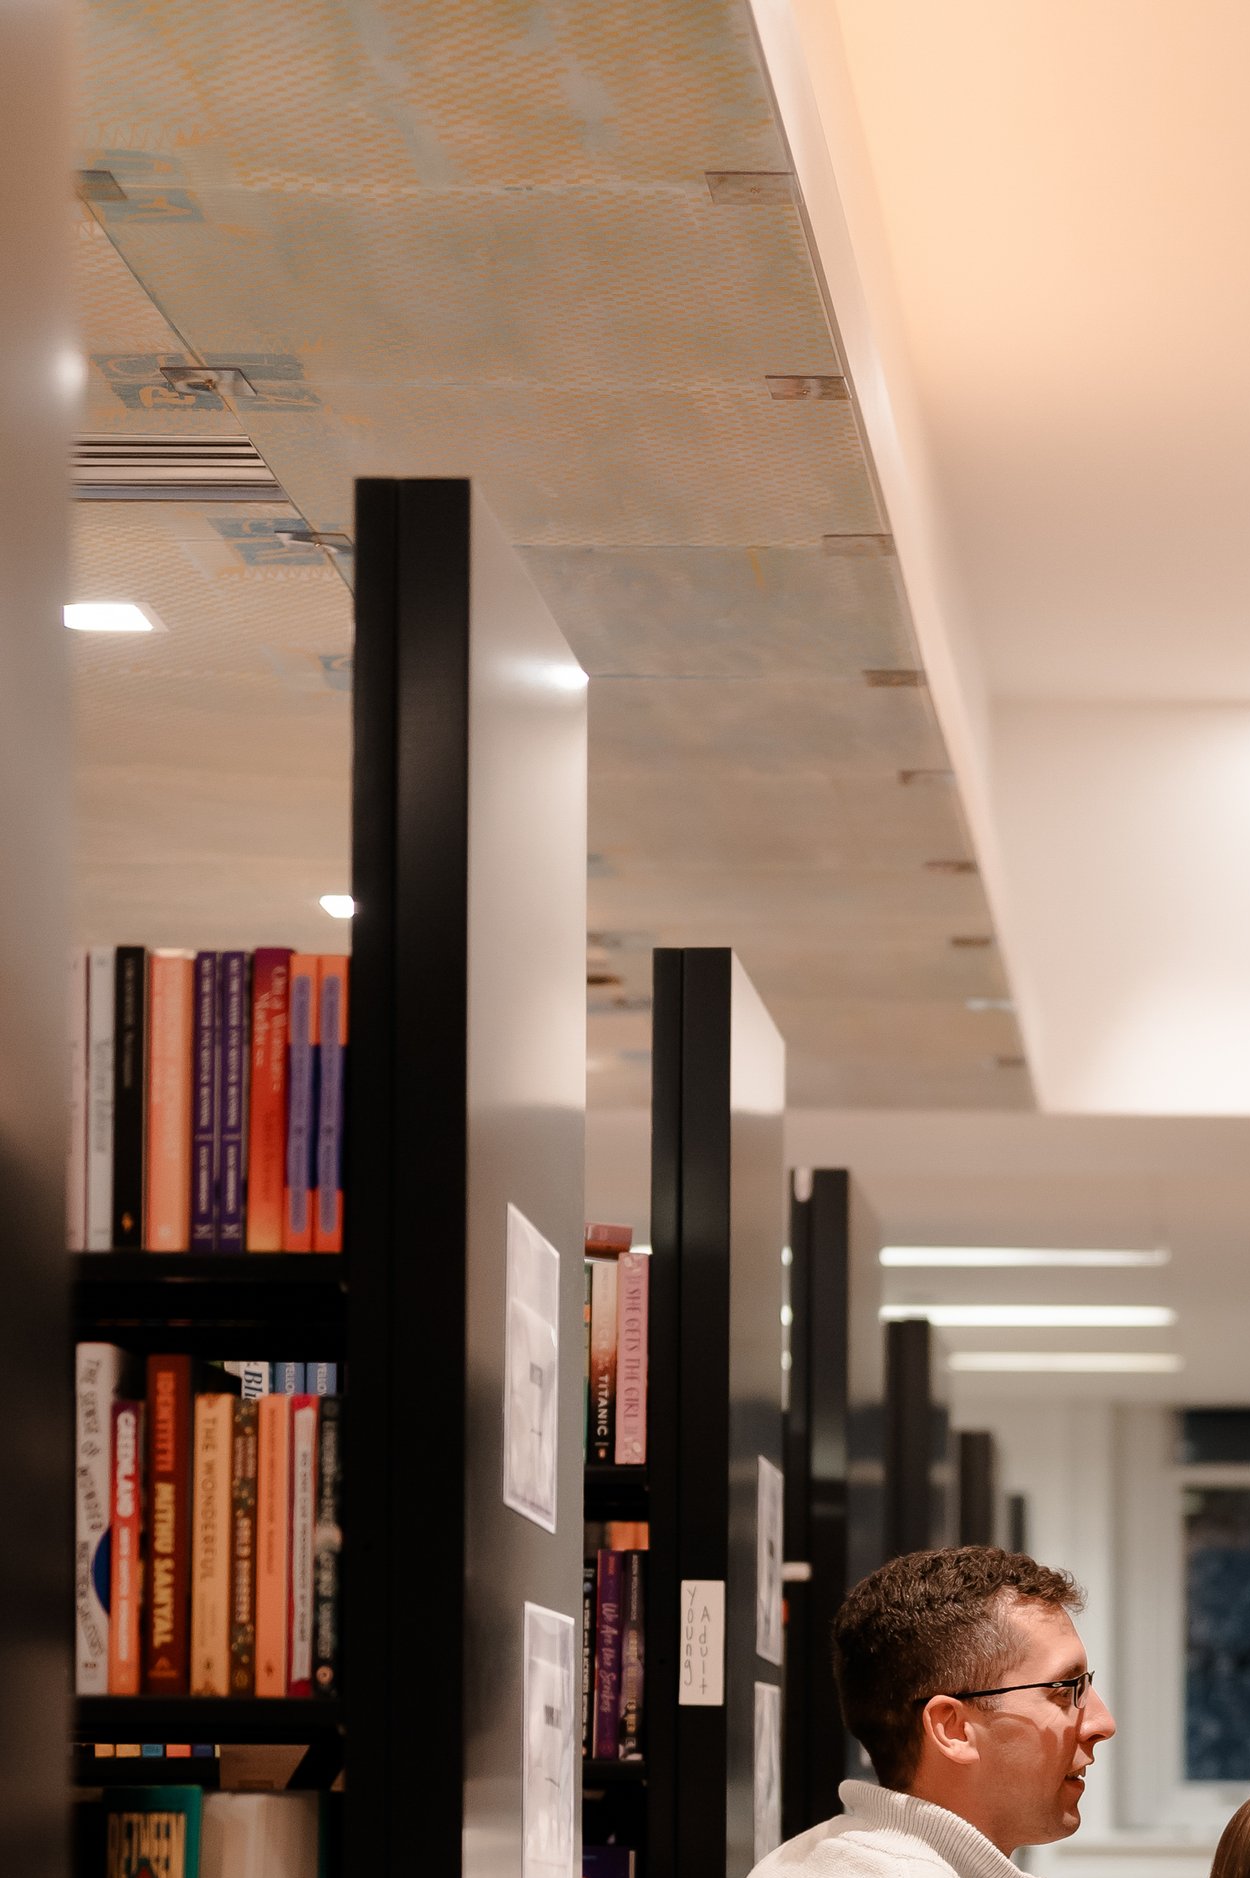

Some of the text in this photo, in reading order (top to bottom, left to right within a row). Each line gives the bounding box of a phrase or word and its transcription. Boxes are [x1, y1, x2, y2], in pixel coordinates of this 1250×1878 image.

[624, 1288, 641, 1419] SHE GETS THE GIRL
[597, 1374, 609, 1436] TITANIC
[602, 1603, 618, 1622] We
[600, 1625, 618, 1646] Are
[699, 1606, 711, 1695] Adult
[601, 1648, 617, 1666] the
